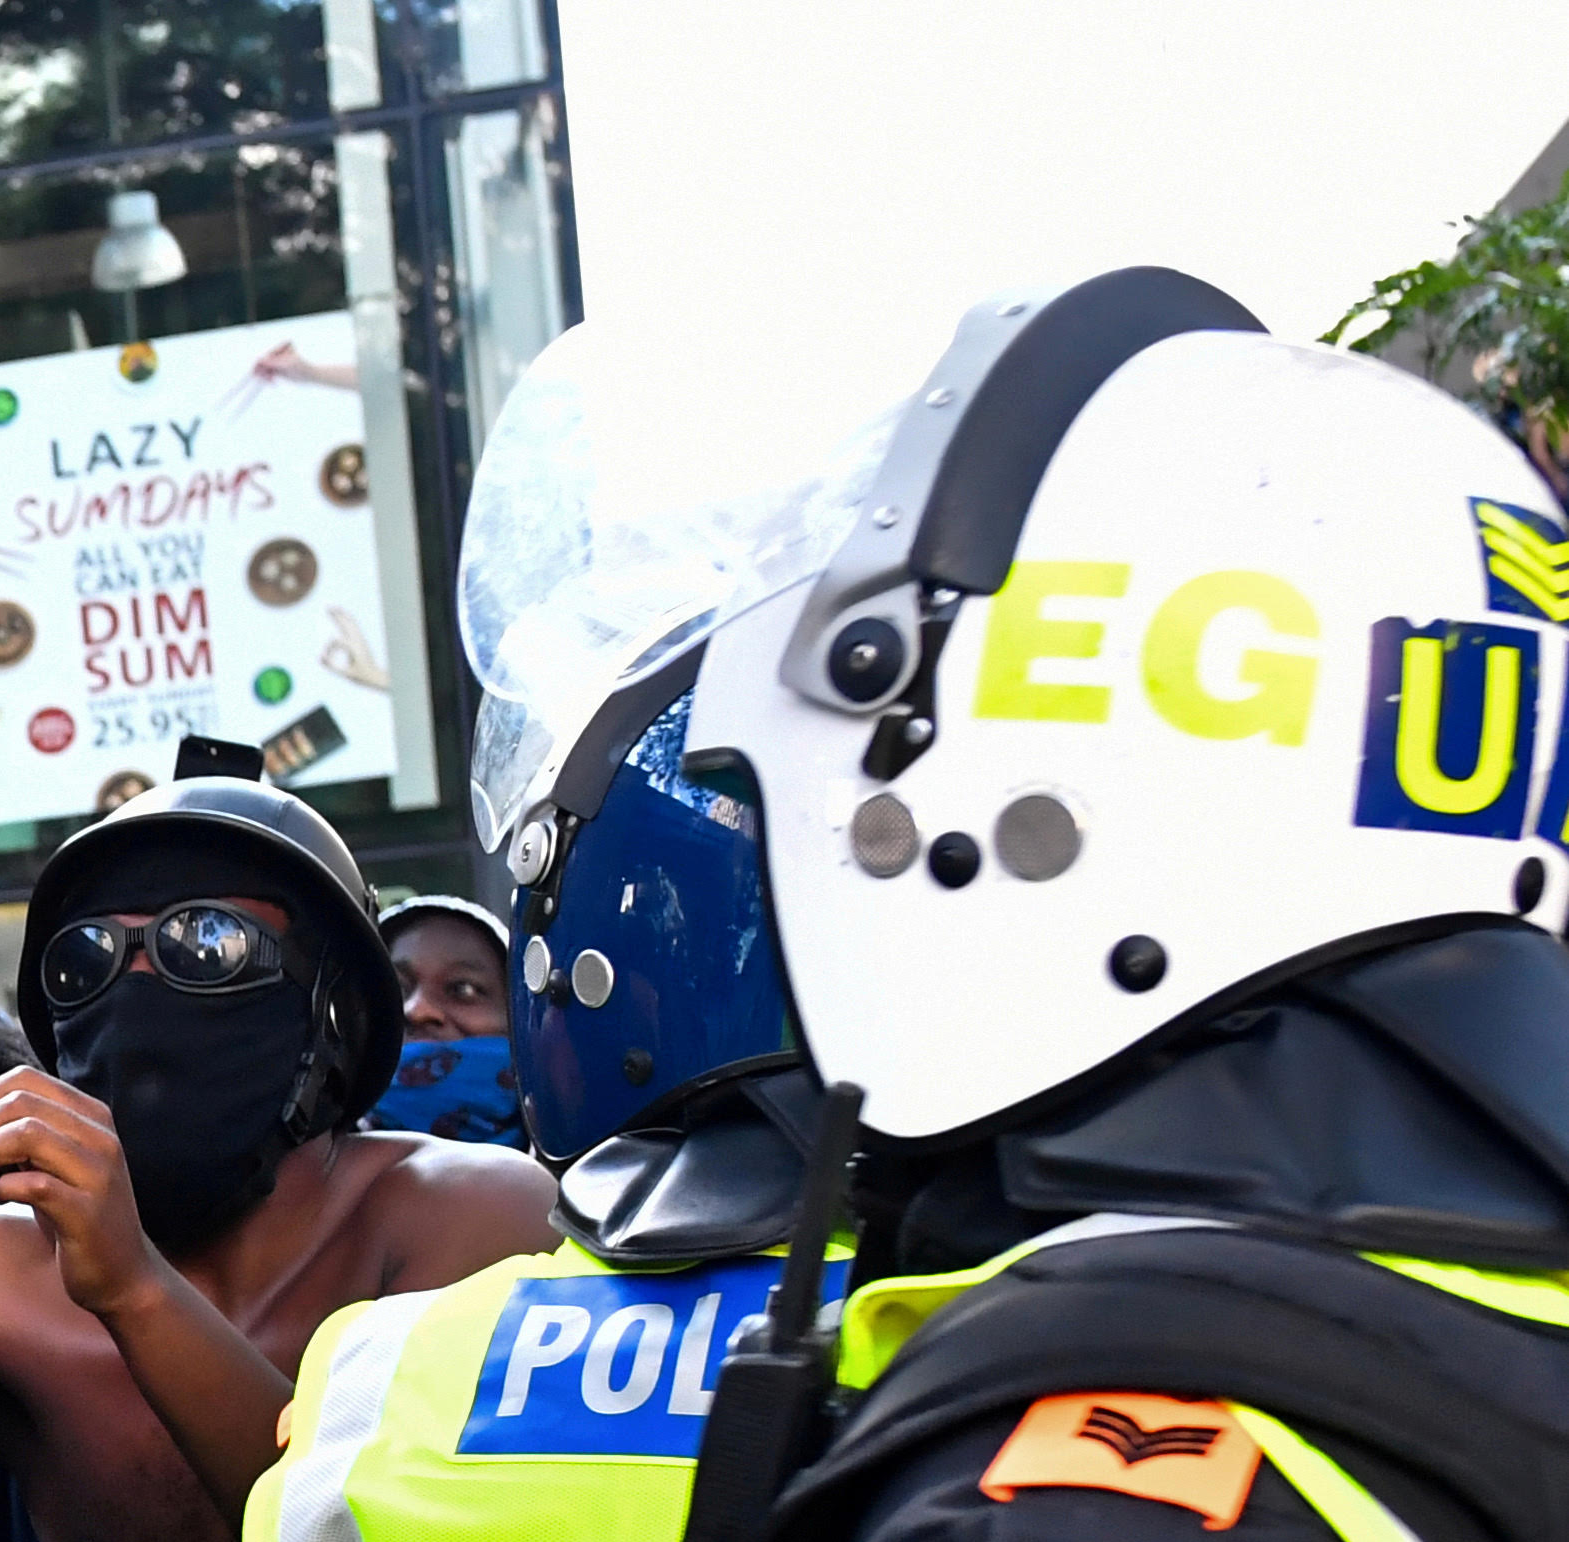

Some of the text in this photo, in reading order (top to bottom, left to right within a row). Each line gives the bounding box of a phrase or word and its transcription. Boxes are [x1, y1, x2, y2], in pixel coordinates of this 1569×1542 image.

[50, 417, 202, 478] LAZY
[15, 461, 275, 543] SUMDAYS
[76, 532, 205, 568] ALL YOU
[76, 553, 204, 596] CAN EAT
[81, 588, 208, 647] DIM
[85, 639, 213, 694] SUM
[971, 560, 1321, 747] EG
[93, 707, 194, 747] 25.95
[496, 1292, 724, 1417] POL
